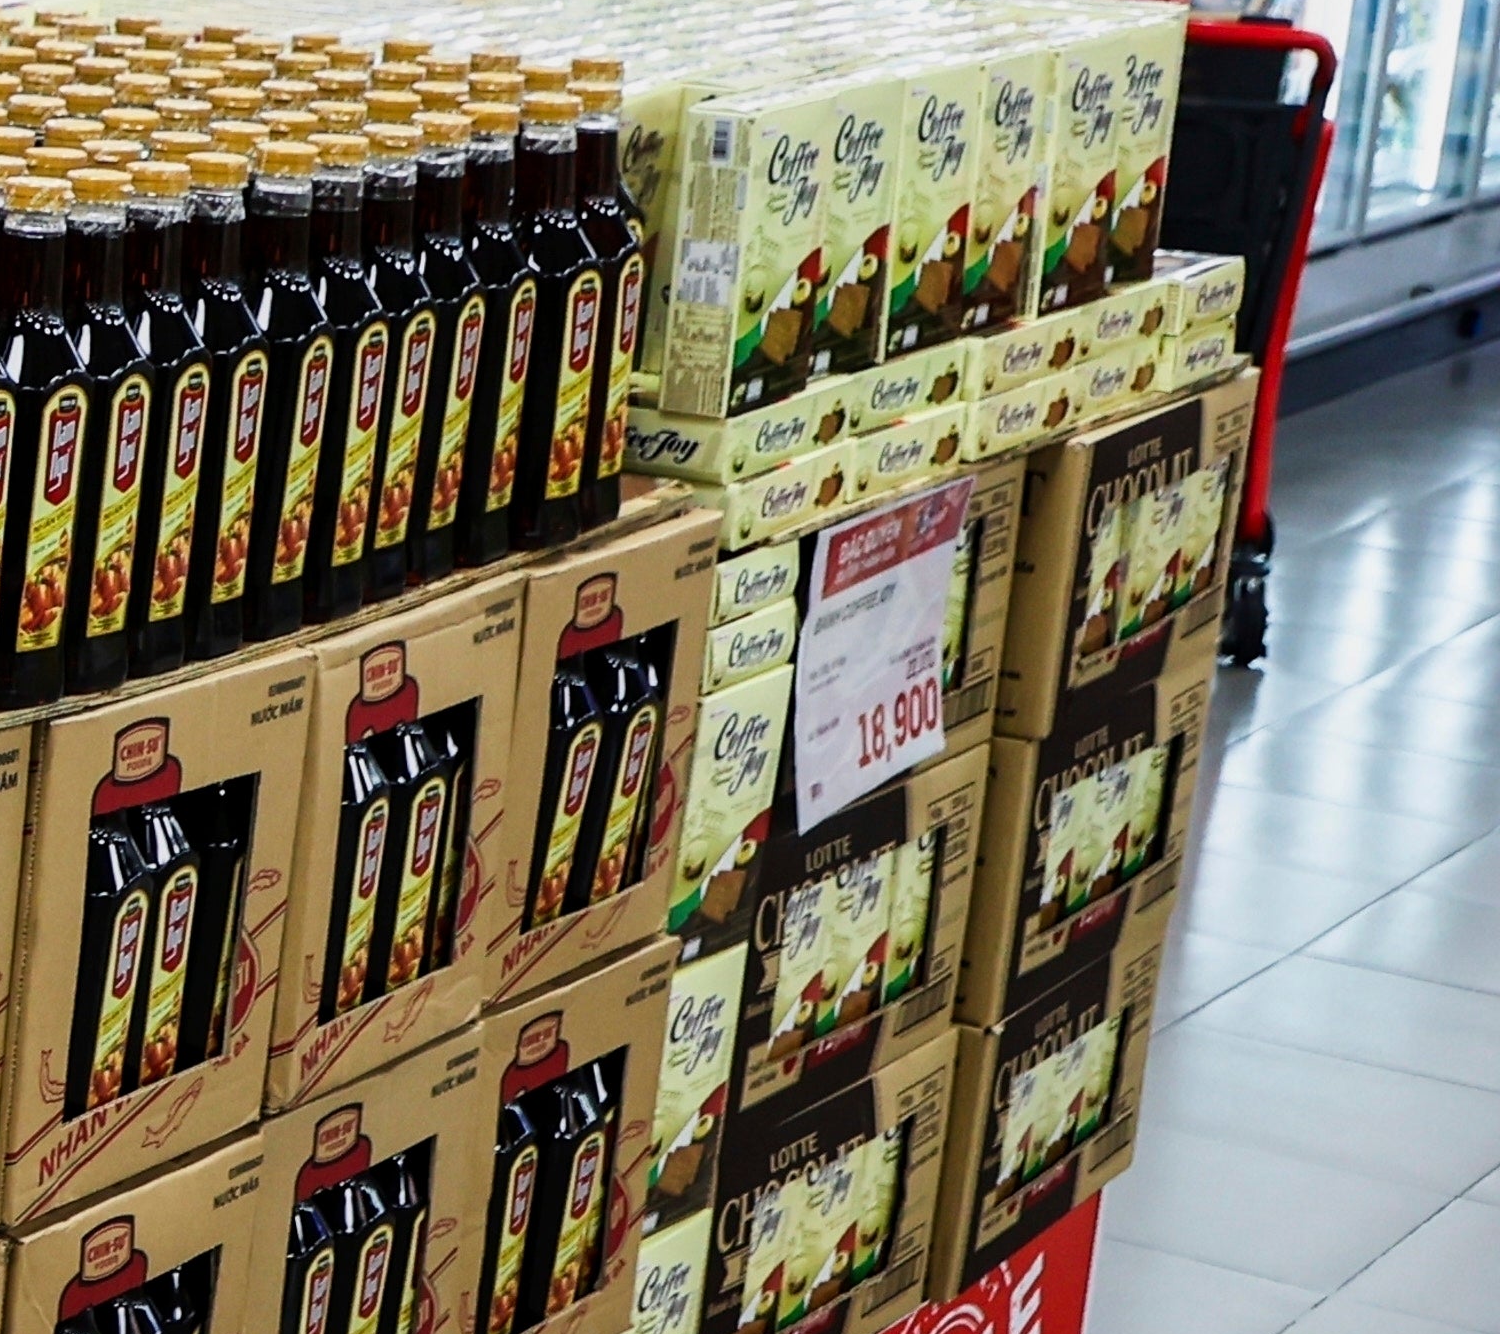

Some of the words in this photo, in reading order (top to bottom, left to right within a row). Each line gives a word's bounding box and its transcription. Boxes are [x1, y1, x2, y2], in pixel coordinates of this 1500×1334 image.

[1072, 67, 1113, 112] Coffee
[769, 135, 819, 186] Coffee
[835, 114, 884, 164] Coffee
[715, 708, 771, 762] Coffee
[858, 676, 938, 769] 18,900
[728, 748, 771, 799] Joy
[805, 833, 852, 869] LOTTE
